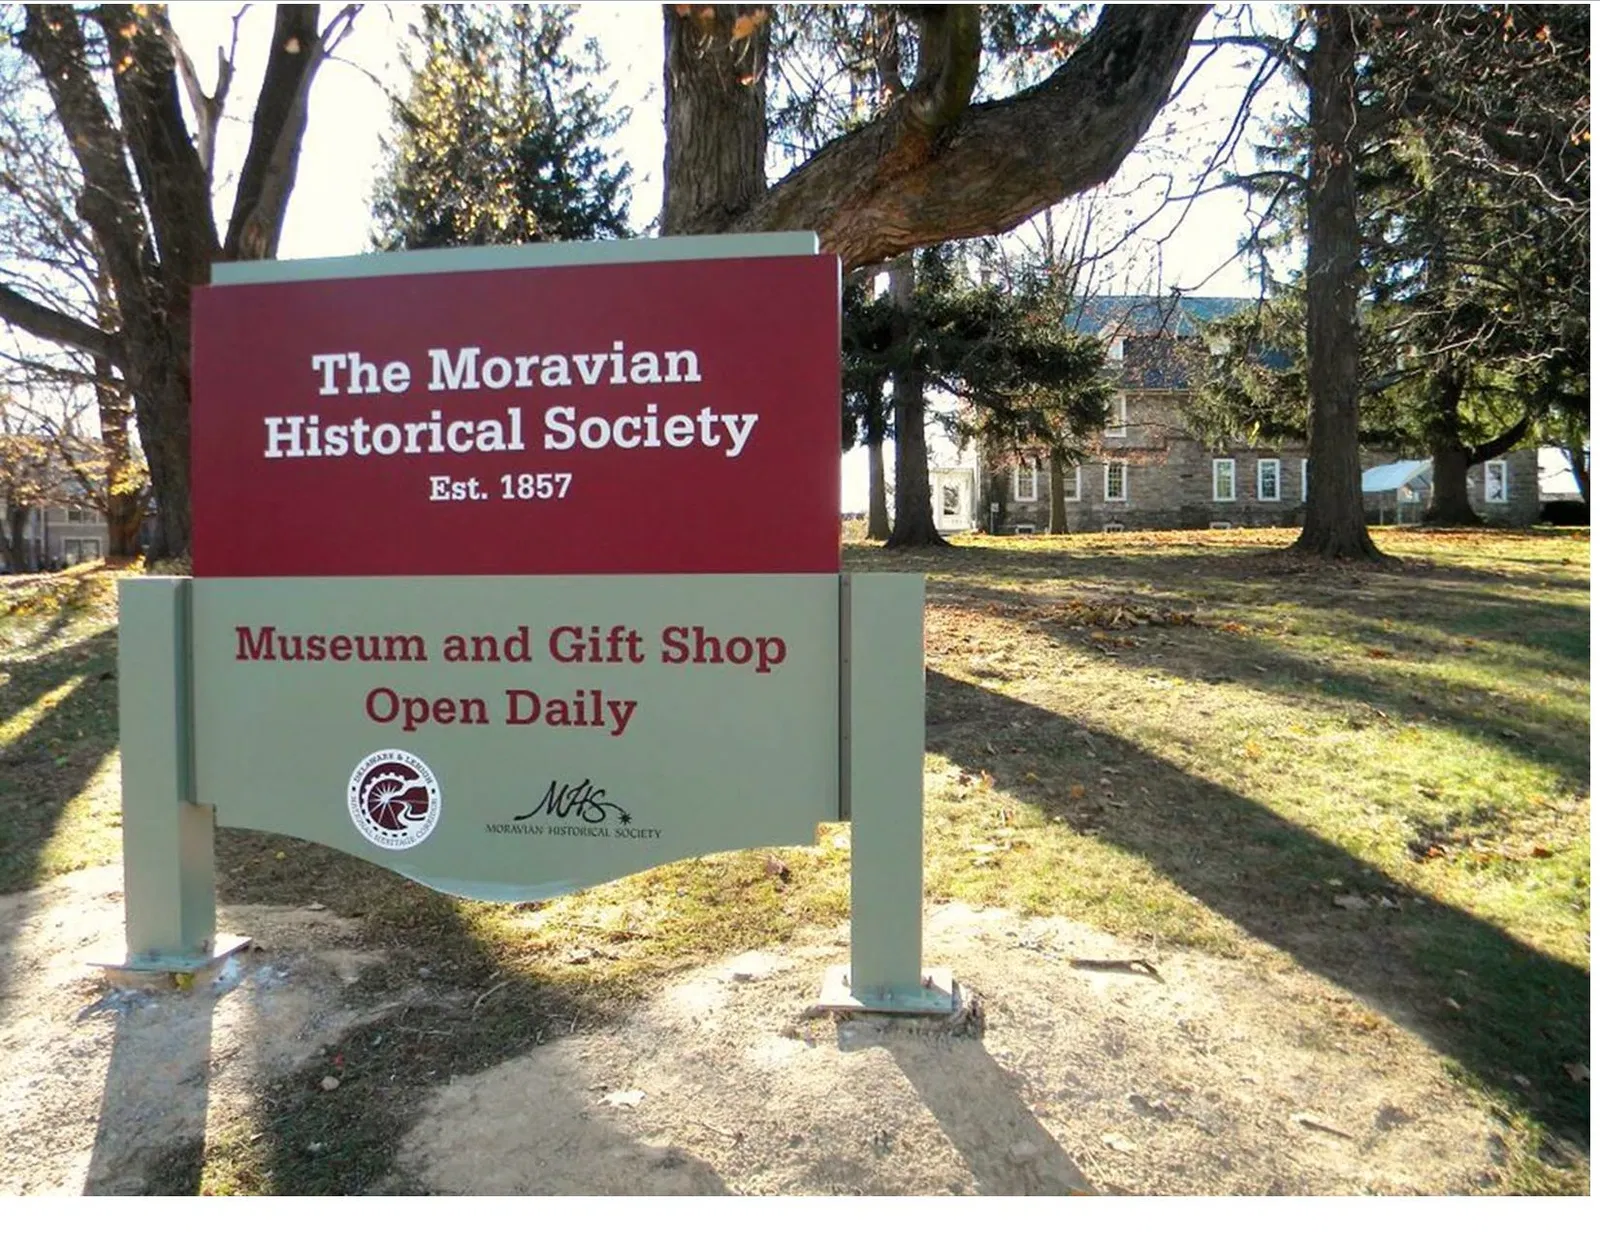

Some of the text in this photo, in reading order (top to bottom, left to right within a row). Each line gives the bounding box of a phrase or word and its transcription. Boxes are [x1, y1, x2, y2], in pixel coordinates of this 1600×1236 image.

[311, 341, 703, 396] The Moravian
[263, 404, 759, 458] Historical Society
[429, 472, 573, 501] Est. 1857
[236, 625, 786, 674] Museum and Gift Shop
[366, 688, 637, 736] Open Daily
[353, 753, 394, 783] DELAWARE
[397, 753, 403, 761] &
[513, 778, 612, 824] MHS
[485, 823, 662, 839] MORAVIAN HISTORICAL SOCIETY
